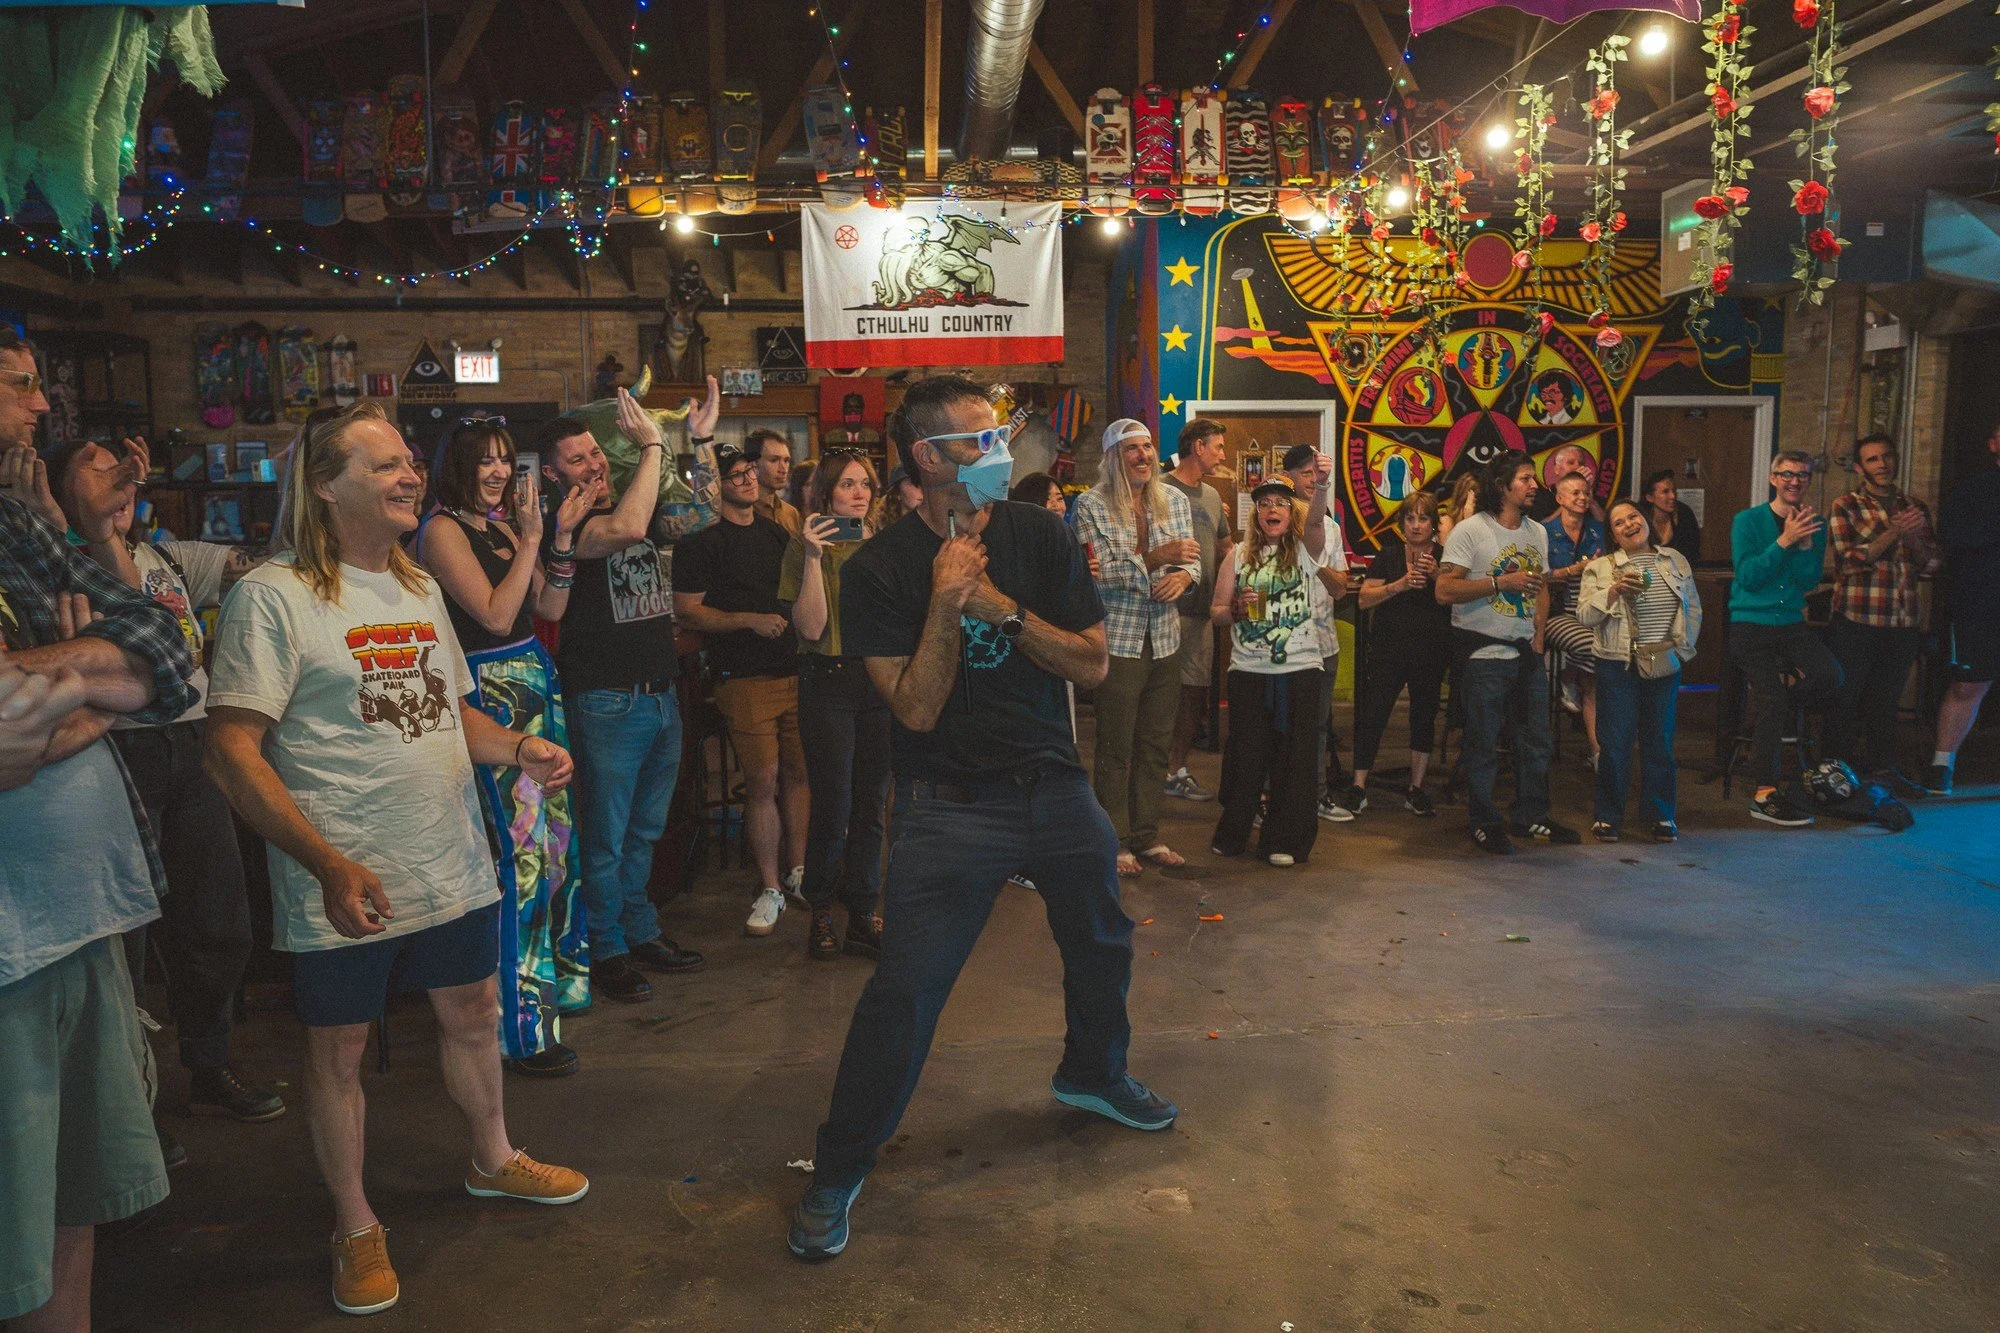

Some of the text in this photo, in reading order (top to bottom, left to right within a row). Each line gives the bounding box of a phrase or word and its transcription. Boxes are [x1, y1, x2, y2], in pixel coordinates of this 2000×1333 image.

[857, 314, 1013, 335] CTHULHU COUNTRY
[1477, 310, 1497, 325] IN
[461, 355, 494, 378] EXIT
[1350, 437, 1376, 517] FIDERITIS
[1596, 458, 1616, 498] CUM
[352, 647, 419, 671] TURF
